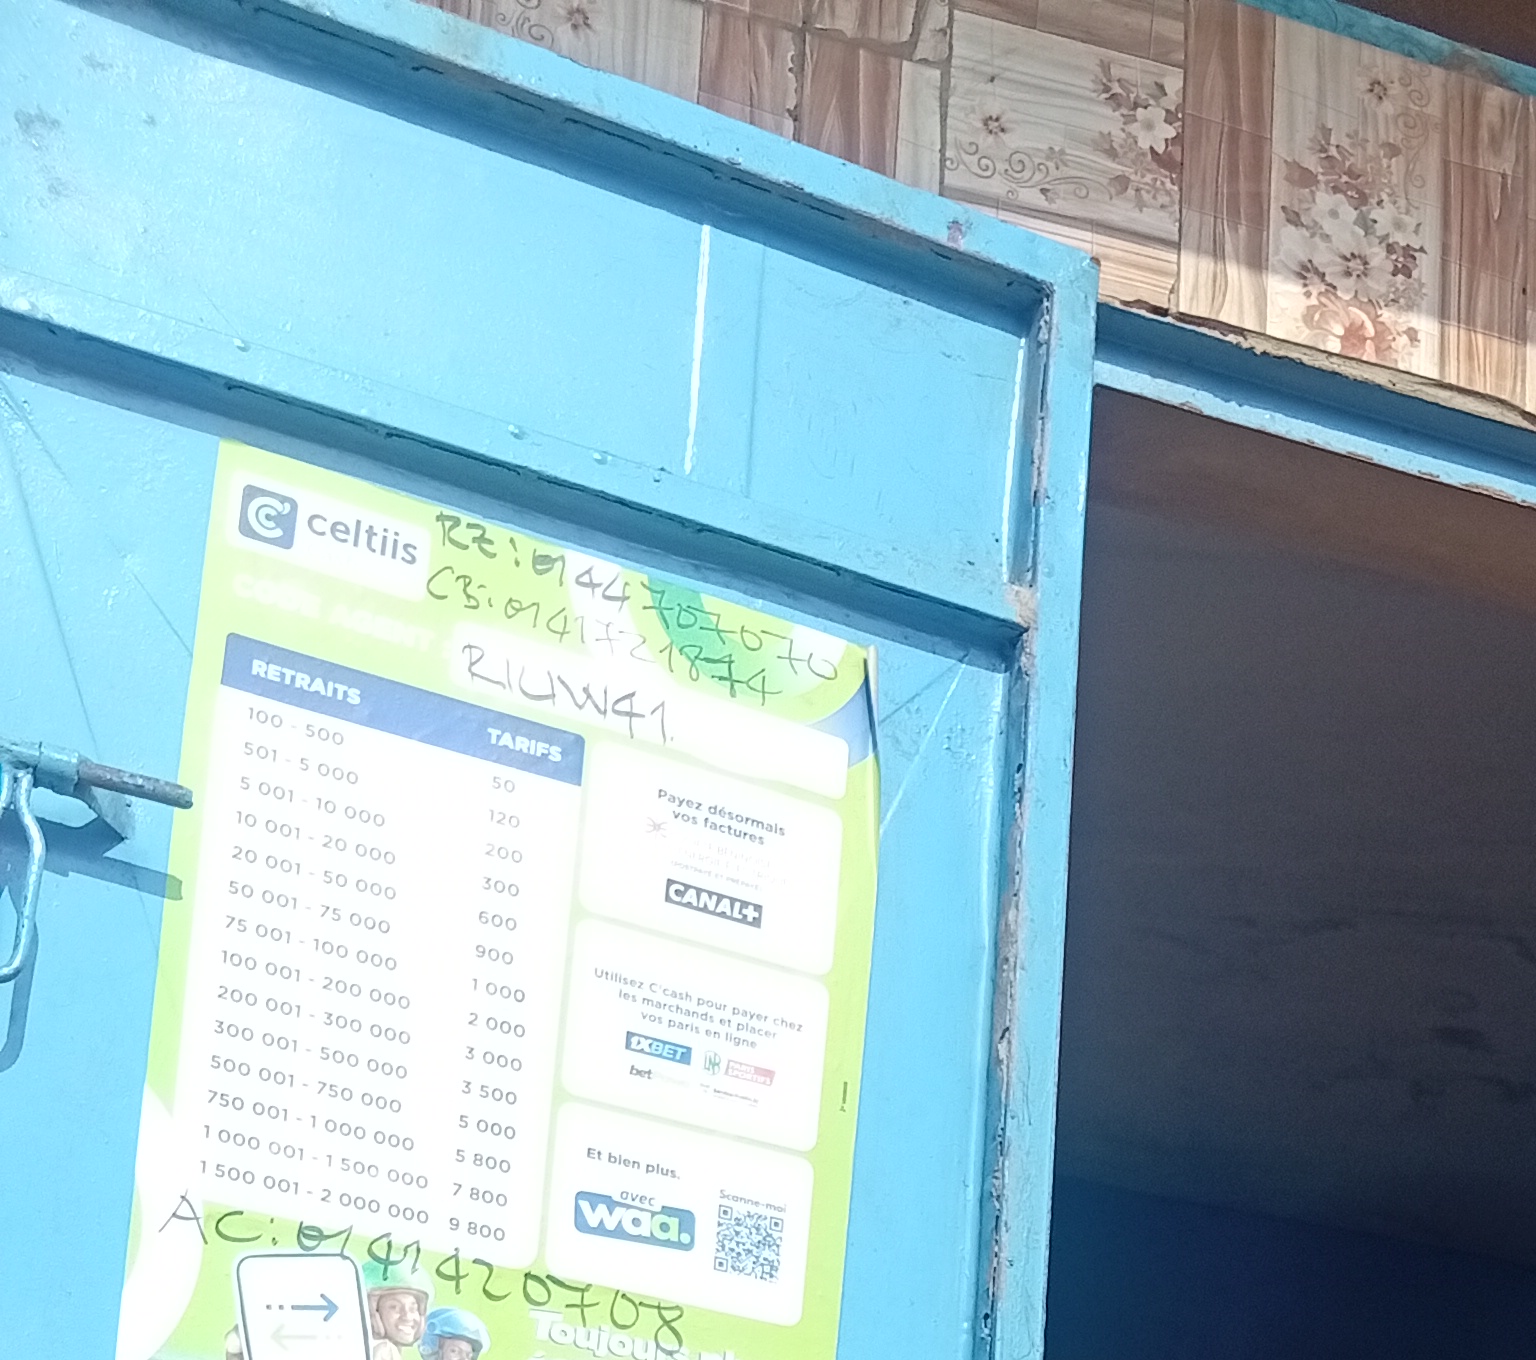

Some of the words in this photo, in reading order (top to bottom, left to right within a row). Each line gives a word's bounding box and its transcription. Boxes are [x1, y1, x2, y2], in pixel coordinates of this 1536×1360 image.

[306, 513, 419, 566] celtiis
[251, 659, 362, 706] RETRAITS
[248, 706, 284, 729] 100
[304, 723, 345, 746] 500
[487, 728, 563, 764] TARIFS
[243, 740, 278, 764] 501
[316, 762, 360, 786] 000
[258, 781, 294, 804] 001
[315, 796, 337, 815] 10
[344, 805, 386, 828] 000
[492, 775, 516, 794] 50
[488, 808, 521, 829] 120
[657, 788, 703, 812] Payez
[707, 802, 787, 837] désormais
[672, 809, 699, 826] vos
[703, 816, 765, 846] factures
[236, 810, 258, 828] 10
[264, 818, 301, 841] 001
[321, 834, 348, 852] 20
[354, 842, 396, 866] 000
[484, 842, 524, 864] 200
[230, 844, 258, 864] 20
[264, 854, 302, 876] 001
[322, 869, 348, 888] 50
[354, 878, 397, 901] 000
[482, 876, 520, 898] 300
[228, 879, 255, 900] 50
[260, 888, 298, 911] 001
[320, 904, 342, 922] 75
[348, 912, 392, 935] 000
[478, 910, 518, 932] 600
[668, 882, 760, 923] CANAL+
[224, 914, 248, 934] 75
[254, 923, 292, 945] 001
[312, 938, 350, 960] 100
[355, 948, 398, 972] 000
[474, 944, 514, 966] 900
[484, 981, 526, 1004] 000
[594, 967, 645, 990] Utilisez
[649, 982, 693, 1003] C'cash
[696, 996, 727, 1013] pour
[732, 1006, 769, 1024] payer
[772, 1016, 804, 1033] chez
[618, 989, 638, 1003] les
[641, 994, 715, 1024] marchands
[719, 1016, 732, 1029] et
[736, 1020, 778, 1040] placer
[640, 1010, 664, 1026] vos
[667, 1015, 700, 1034] paris
[704, 1028, 721, 1041] en
[725, 1031, 758, 1050] ligne
[472, 1152, 512, 1174] 800
[586, 1147, 603, 1161] Et
[607, 1152, 641, 1170] bien
[645, 1162, 681, 1181] plus.
[214, 1162, 256, 1186] 500
[262, 1174, 300, 1196] 001
[338, 1192, 382, 1214] 000
[387, 1203, 430, 1226] 000
[619, 1188, 656, 1207] avec
[719, 1188, 788, 1214] Scanne-moi
[466, 1220, 506, 1242] 800
